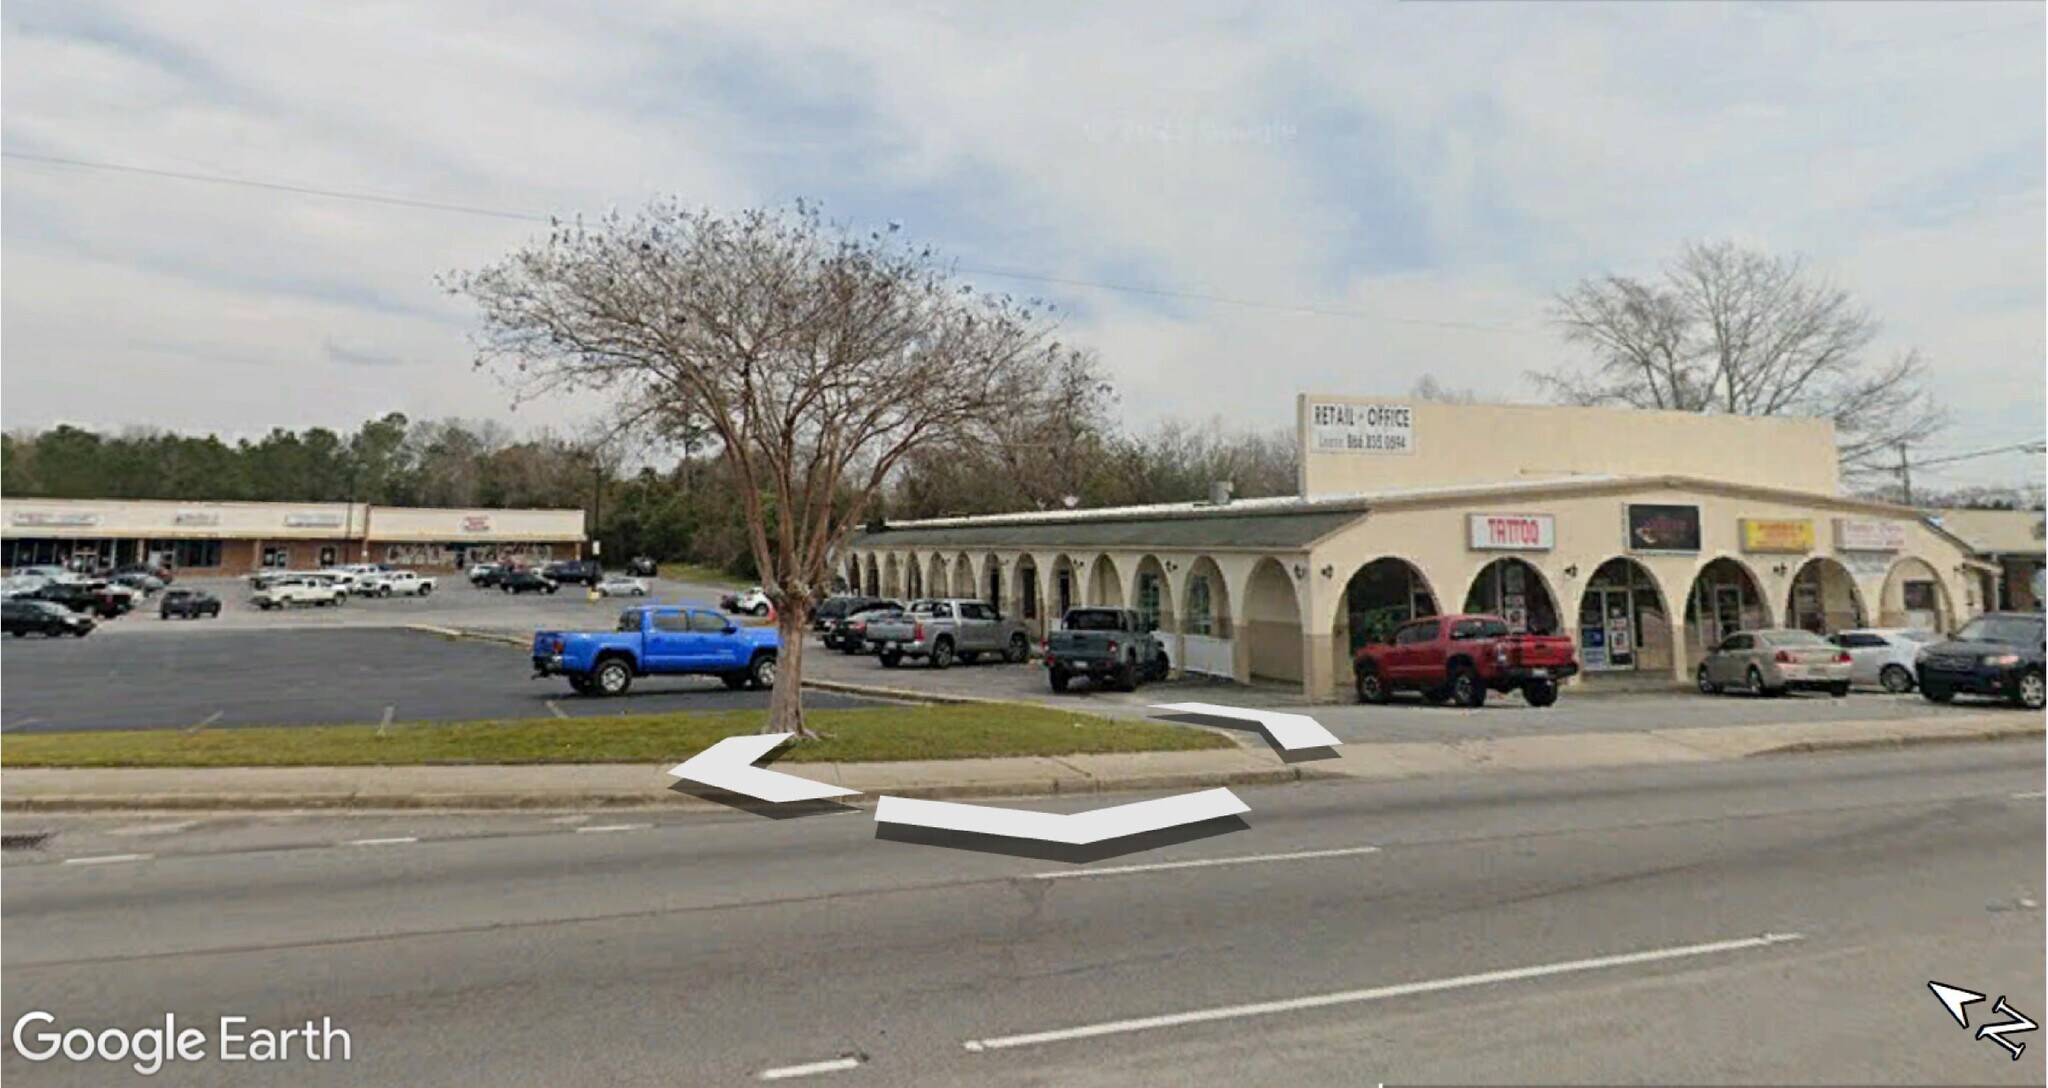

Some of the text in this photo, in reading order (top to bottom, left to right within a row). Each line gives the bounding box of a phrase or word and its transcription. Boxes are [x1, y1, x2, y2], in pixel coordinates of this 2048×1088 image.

[1314, 405, 1354, 426] RETAIL
[1367, 407, 1410, 428] OFFICE
[1487, 518, 1540, 545] TATTOO
